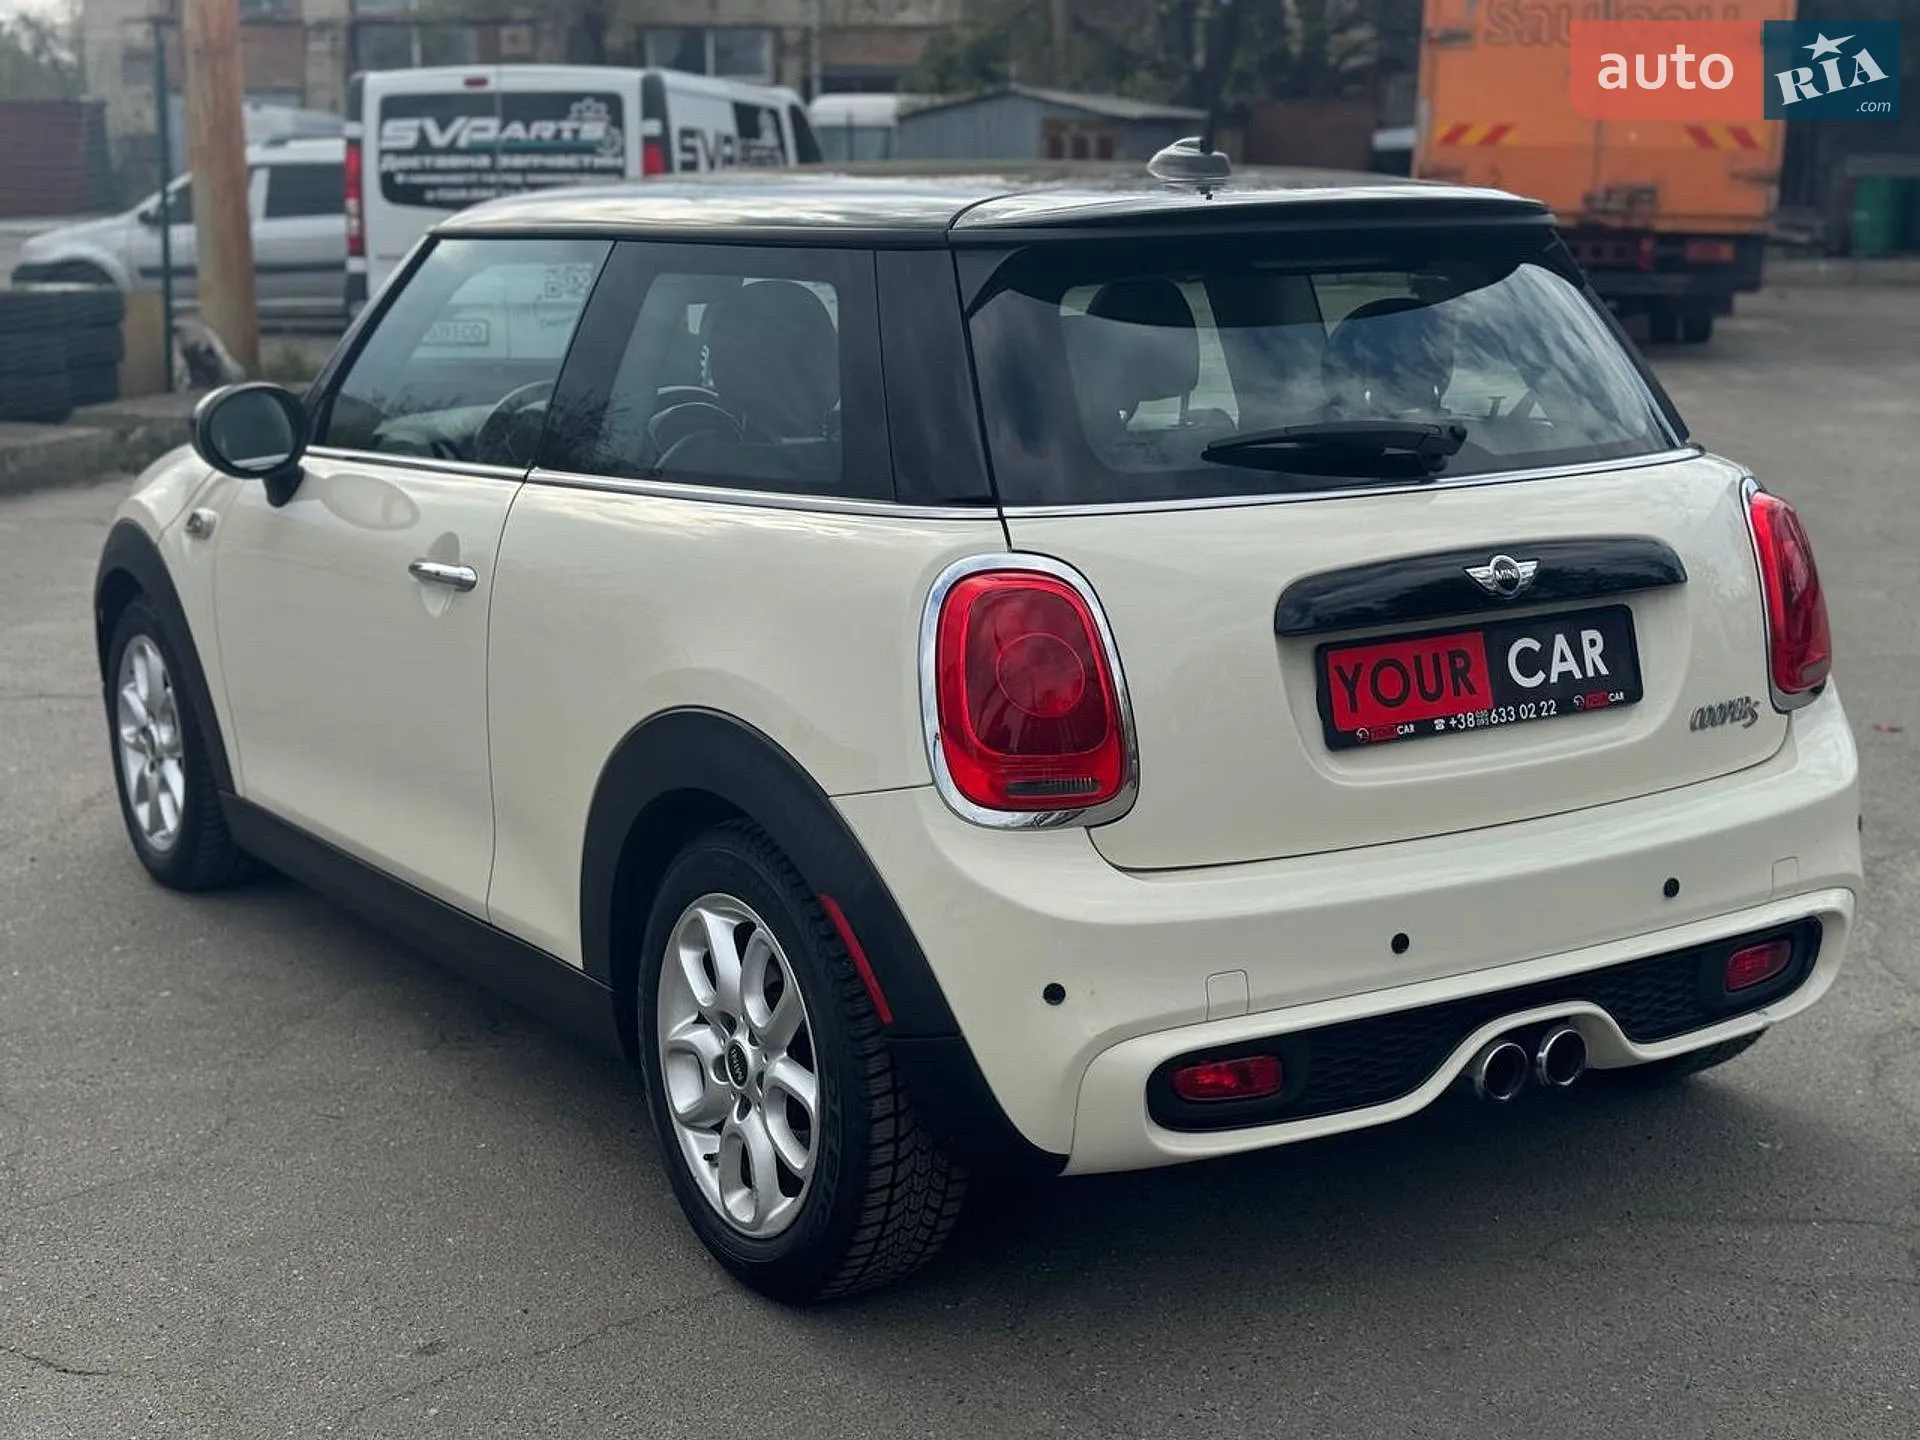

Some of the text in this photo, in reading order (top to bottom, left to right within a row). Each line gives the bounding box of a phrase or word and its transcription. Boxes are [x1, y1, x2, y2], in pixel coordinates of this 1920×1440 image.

[1334, 629, 1610, 714] YOUR CAR
[1396, 723, 1416, 735] CAR
[1449, 711, 1475, 729] +38
[1490, 706, 1516, 725] 633
[1519, 702, 1537, 720] 02
[1540, 699, 1557, 716] 22
